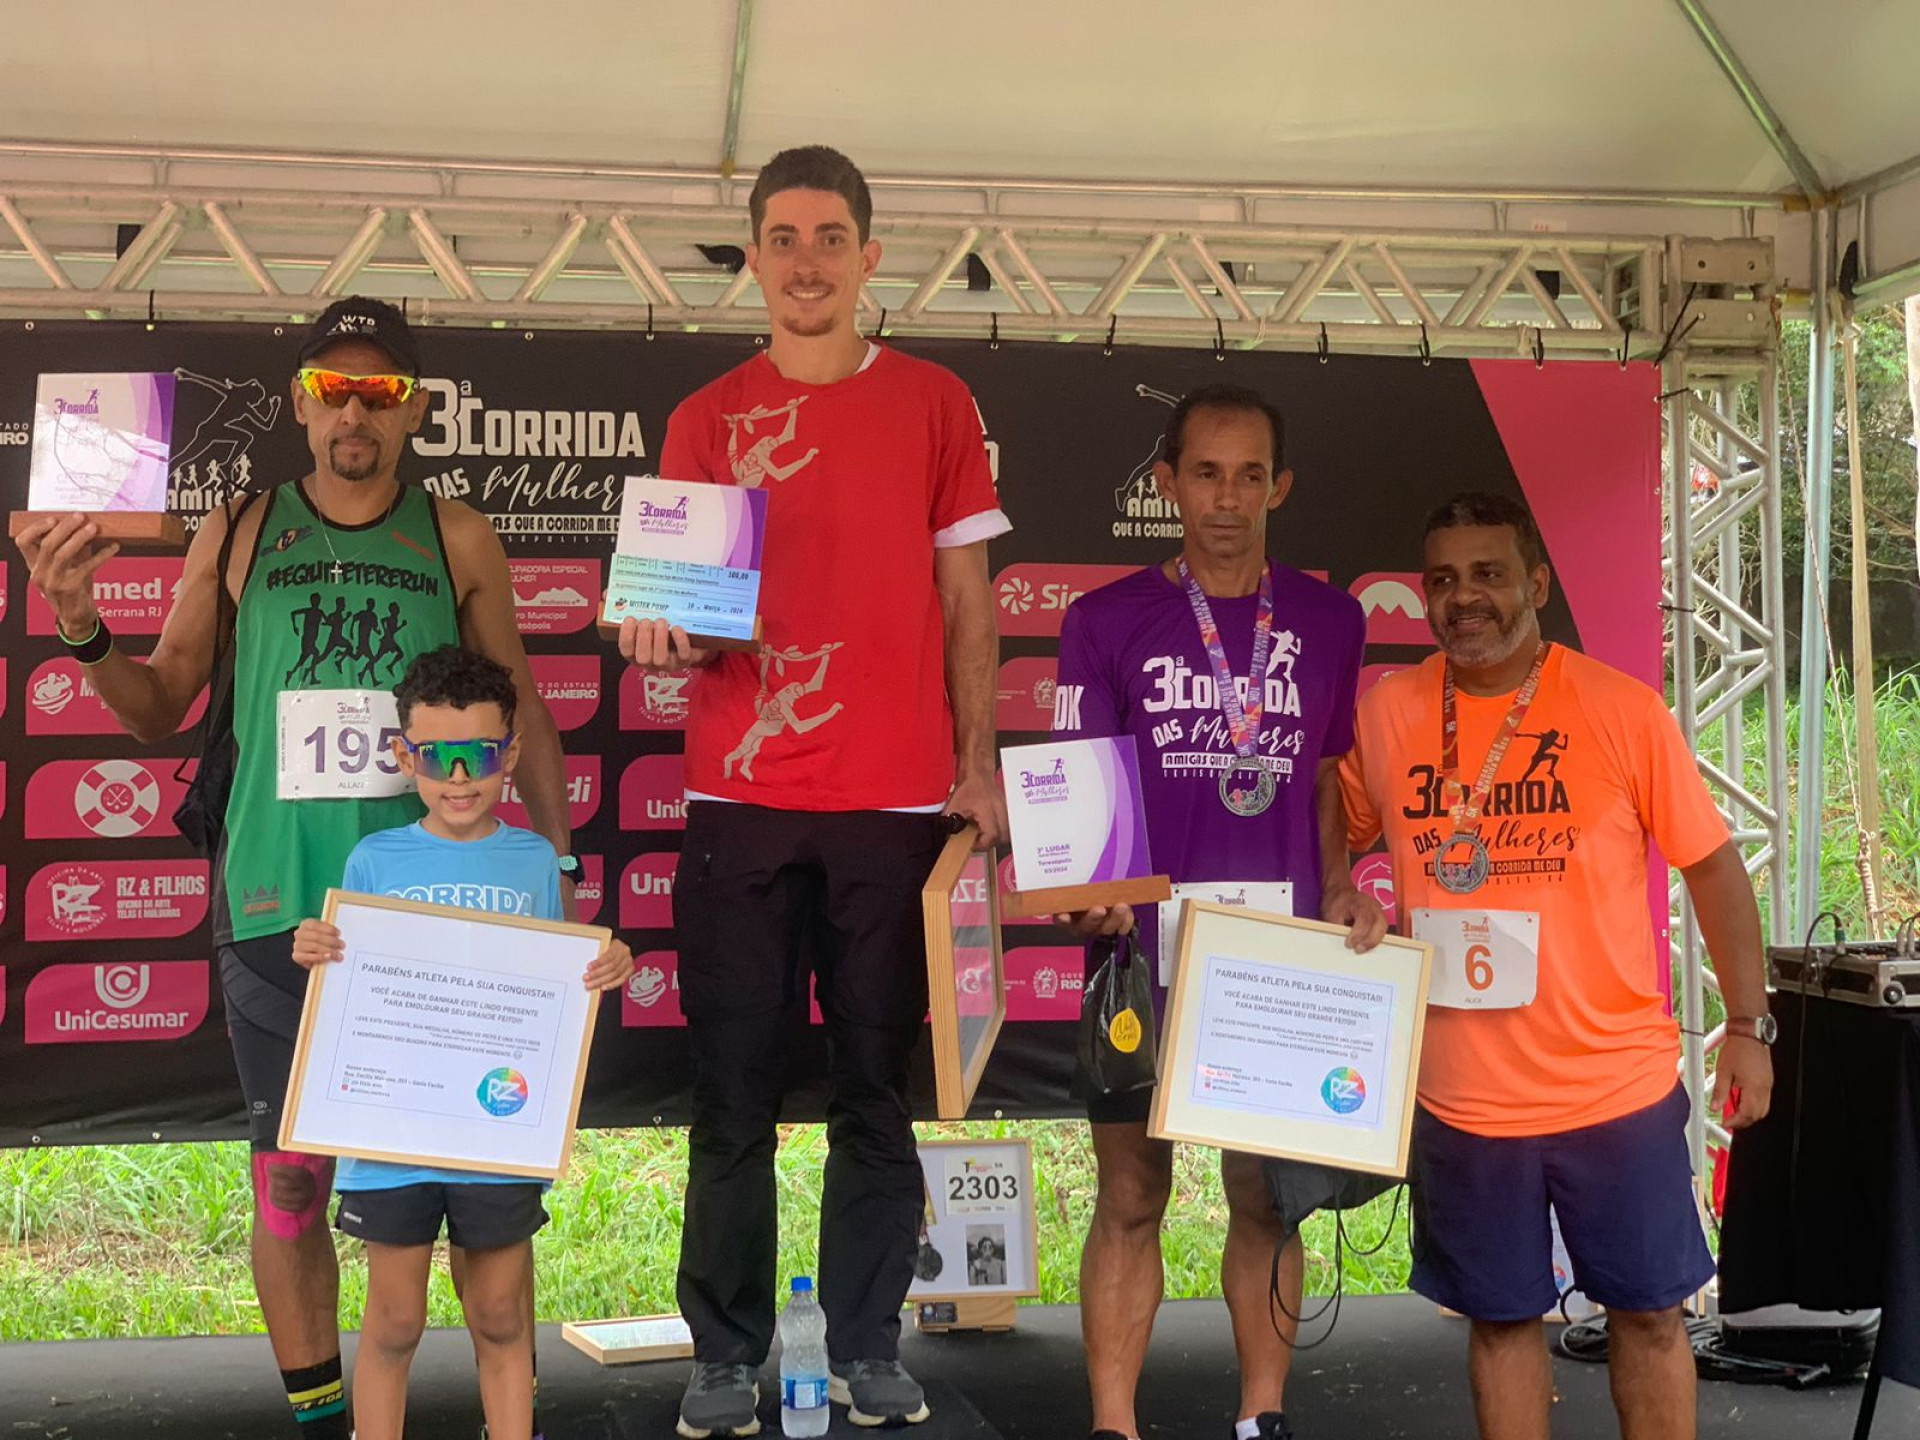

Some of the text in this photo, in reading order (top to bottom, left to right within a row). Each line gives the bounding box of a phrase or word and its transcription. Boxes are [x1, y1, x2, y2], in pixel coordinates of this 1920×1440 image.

[455, 397, 646, 458] CORRIDA
[514, 517, 535, 532] QUE
[537, 517, 545, 531] A
[546, 517, 595, 532] CORRIDA
[1112, 522, 1132, 538] QUE
[1134, 523, 1142, 538] A
[98, 607, 162, 617] Serrana RJ
[545, 689, 598, 699] JANEIRO
[1152, 718, 1184, 748] DAS
[304, 726, 404, 775] 195
[1165, 755, 1207, 766] AMIGAS
[116, 875, 205, 897] RZ & FILHOS
[361, 962, 413, 979] PARABÉNS
[414, 971, 449, 984] ATLETA
[449, 976, 474, 987] PELA
[476, 980, 495, 991] SUA
[1464, 943, 1495, 991] 6
[371, 985, 390, 996] VOCÊ
[391, 989, 415, 999] ACABA
[1215, 968, 1259, 983] PARABÉNS
[1260, 975, 1290, 988] ATLETA
[1291, 980, 1312, 991] PELA
[1313, 983, 1331, 994] SUA
[54, 1009, 189, 1032] UniCesumar
[948, 1175, 1019, 1201] 2303
